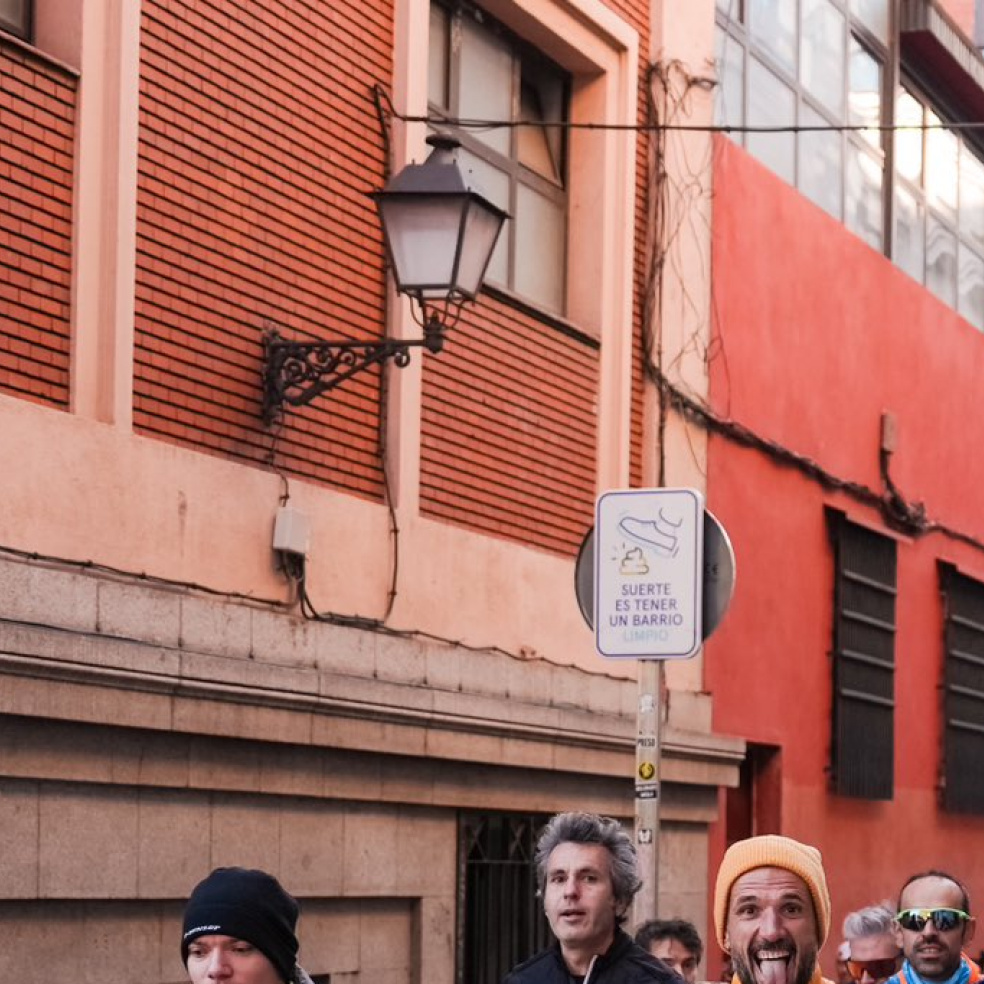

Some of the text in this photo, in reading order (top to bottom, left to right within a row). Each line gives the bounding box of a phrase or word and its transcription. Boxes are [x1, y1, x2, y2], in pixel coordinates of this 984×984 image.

[621, 583, 671, 596] SUERTE
[615, 598, 678, 611] ES TENER
[609, 613, 683, 627] UN BARRIO
[623, 628, 669, 642] LIMPIO
